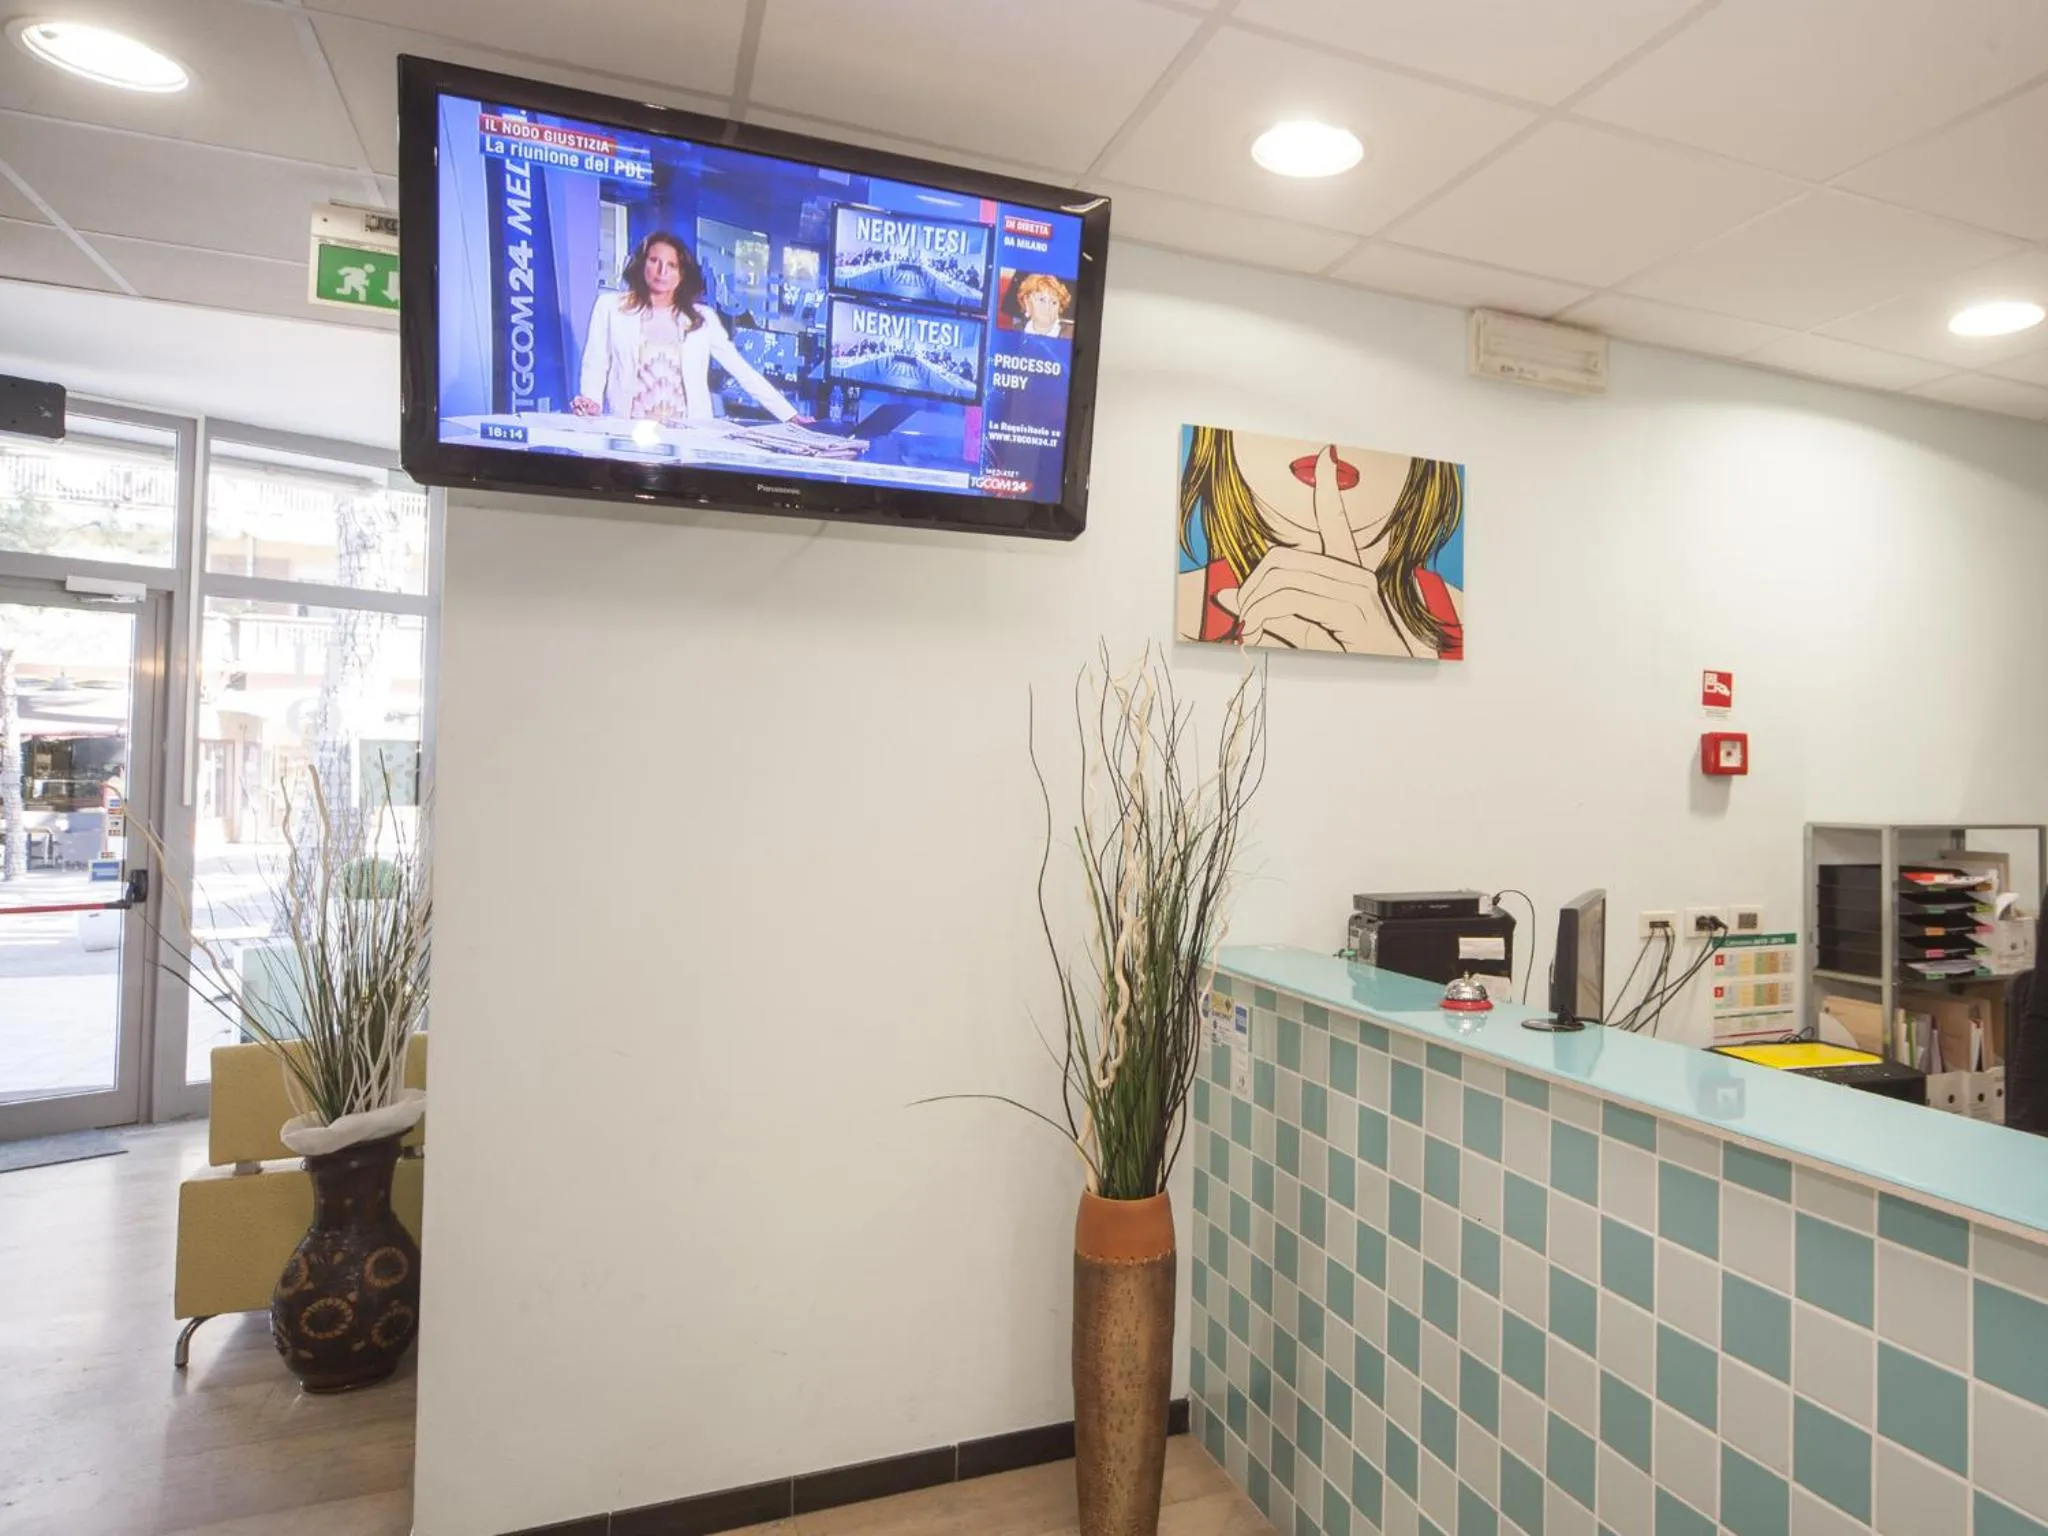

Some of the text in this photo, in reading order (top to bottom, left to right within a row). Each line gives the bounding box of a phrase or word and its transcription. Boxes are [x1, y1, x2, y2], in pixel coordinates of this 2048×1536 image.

[485, 118, 610, 153] IL NODO GIUSTIZIA
[485, 135, 505, 154] La
[510, 142, 580, 168] riunione
[613, 160, 646, 180] PDL
[856, 216, 967, 255] NERVI TESI
[1017, 238, 1048, 252] MILANO
[852, 309, 959, 348] NERVI TESI
[992, 372, 1028, 390] RUBY
[994, 353, 1061, 376] PROCESSO
